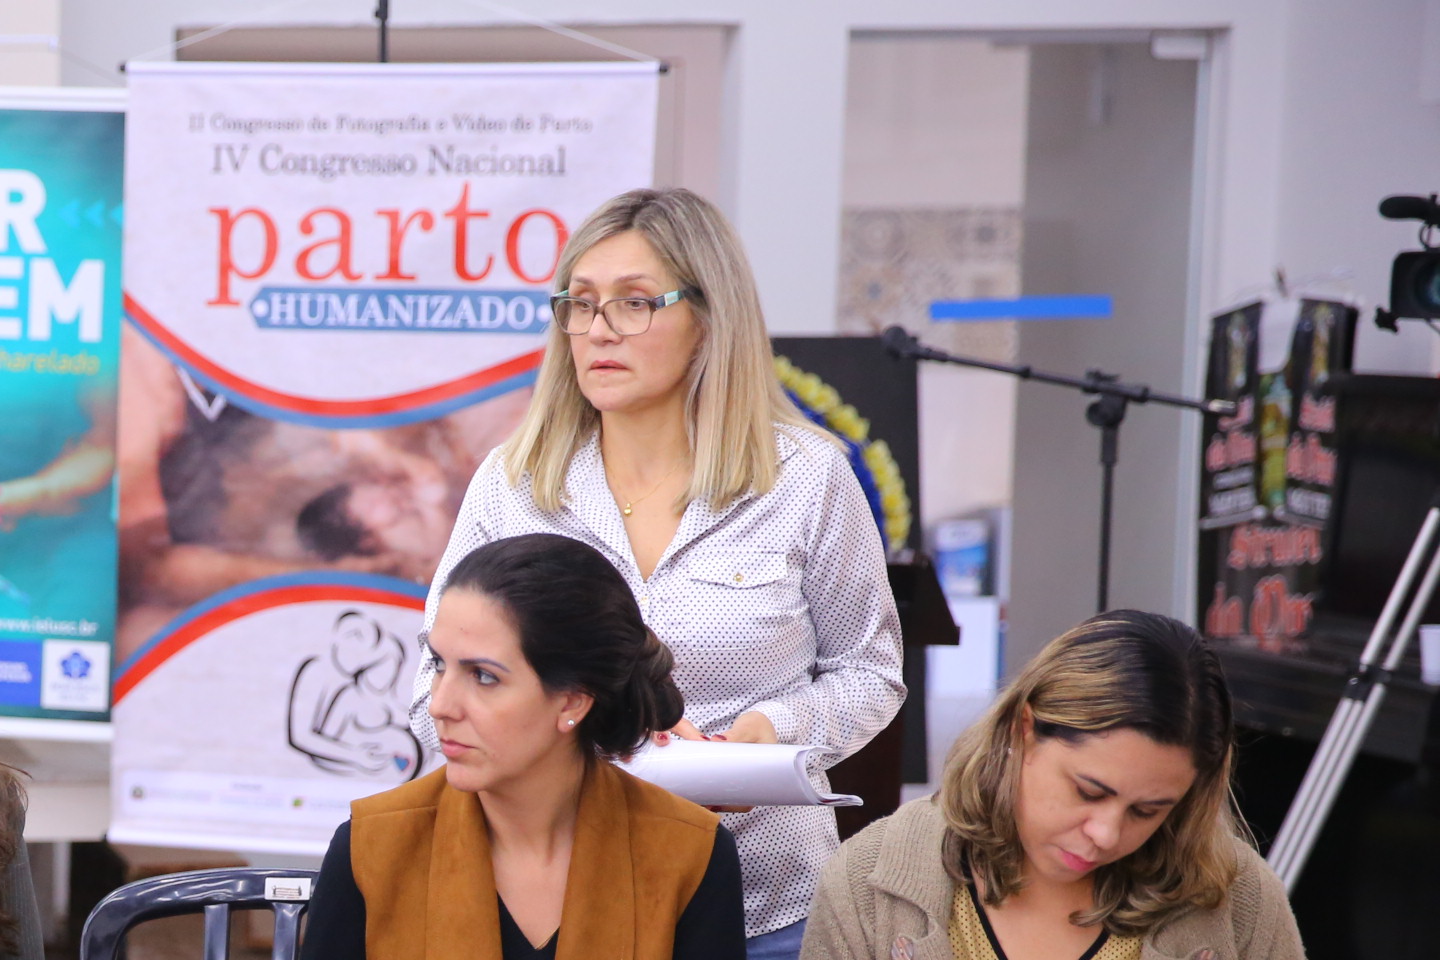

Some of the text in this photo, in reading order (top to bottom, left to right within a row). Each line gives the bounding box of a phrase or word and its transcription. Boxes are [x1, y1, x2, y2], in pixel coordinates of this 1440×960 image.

[212, 143, 567, 183] IV Congresso Nacional
[206, 181, 569, 308] parto
[268, 293, 535, 329] HUMANIZADO
